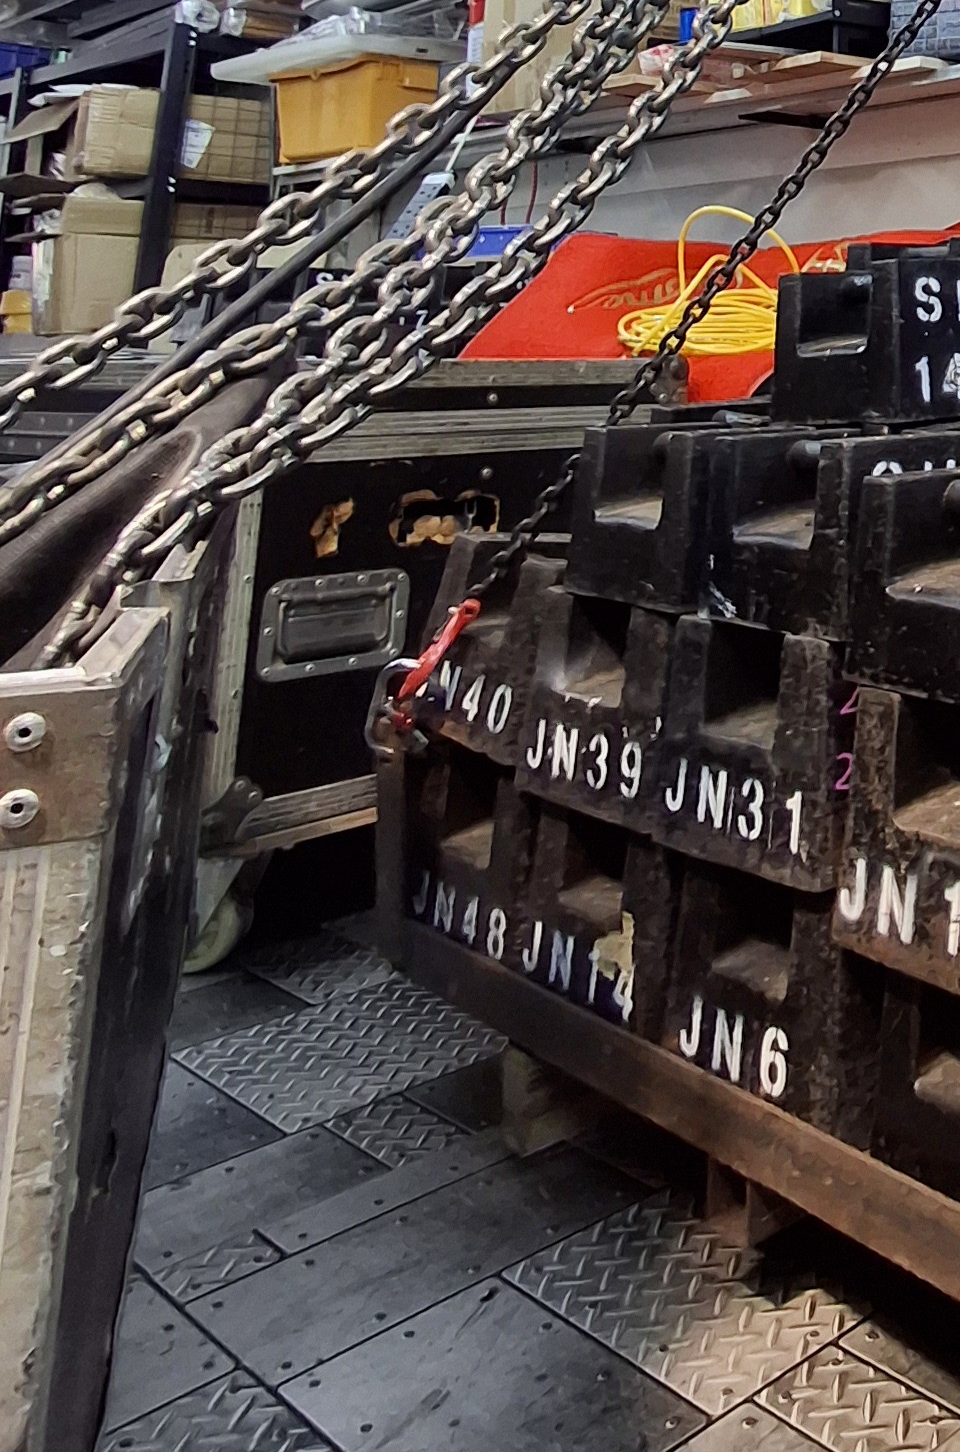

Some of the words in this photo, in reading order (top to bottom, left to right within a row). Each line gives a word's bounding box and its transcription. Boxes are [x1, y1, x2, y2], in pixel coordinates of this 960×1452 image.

[438, 659, 514, 734] N40
[527, 718, 642, 799] JN39
[665, 758, 802, 854] JN31
